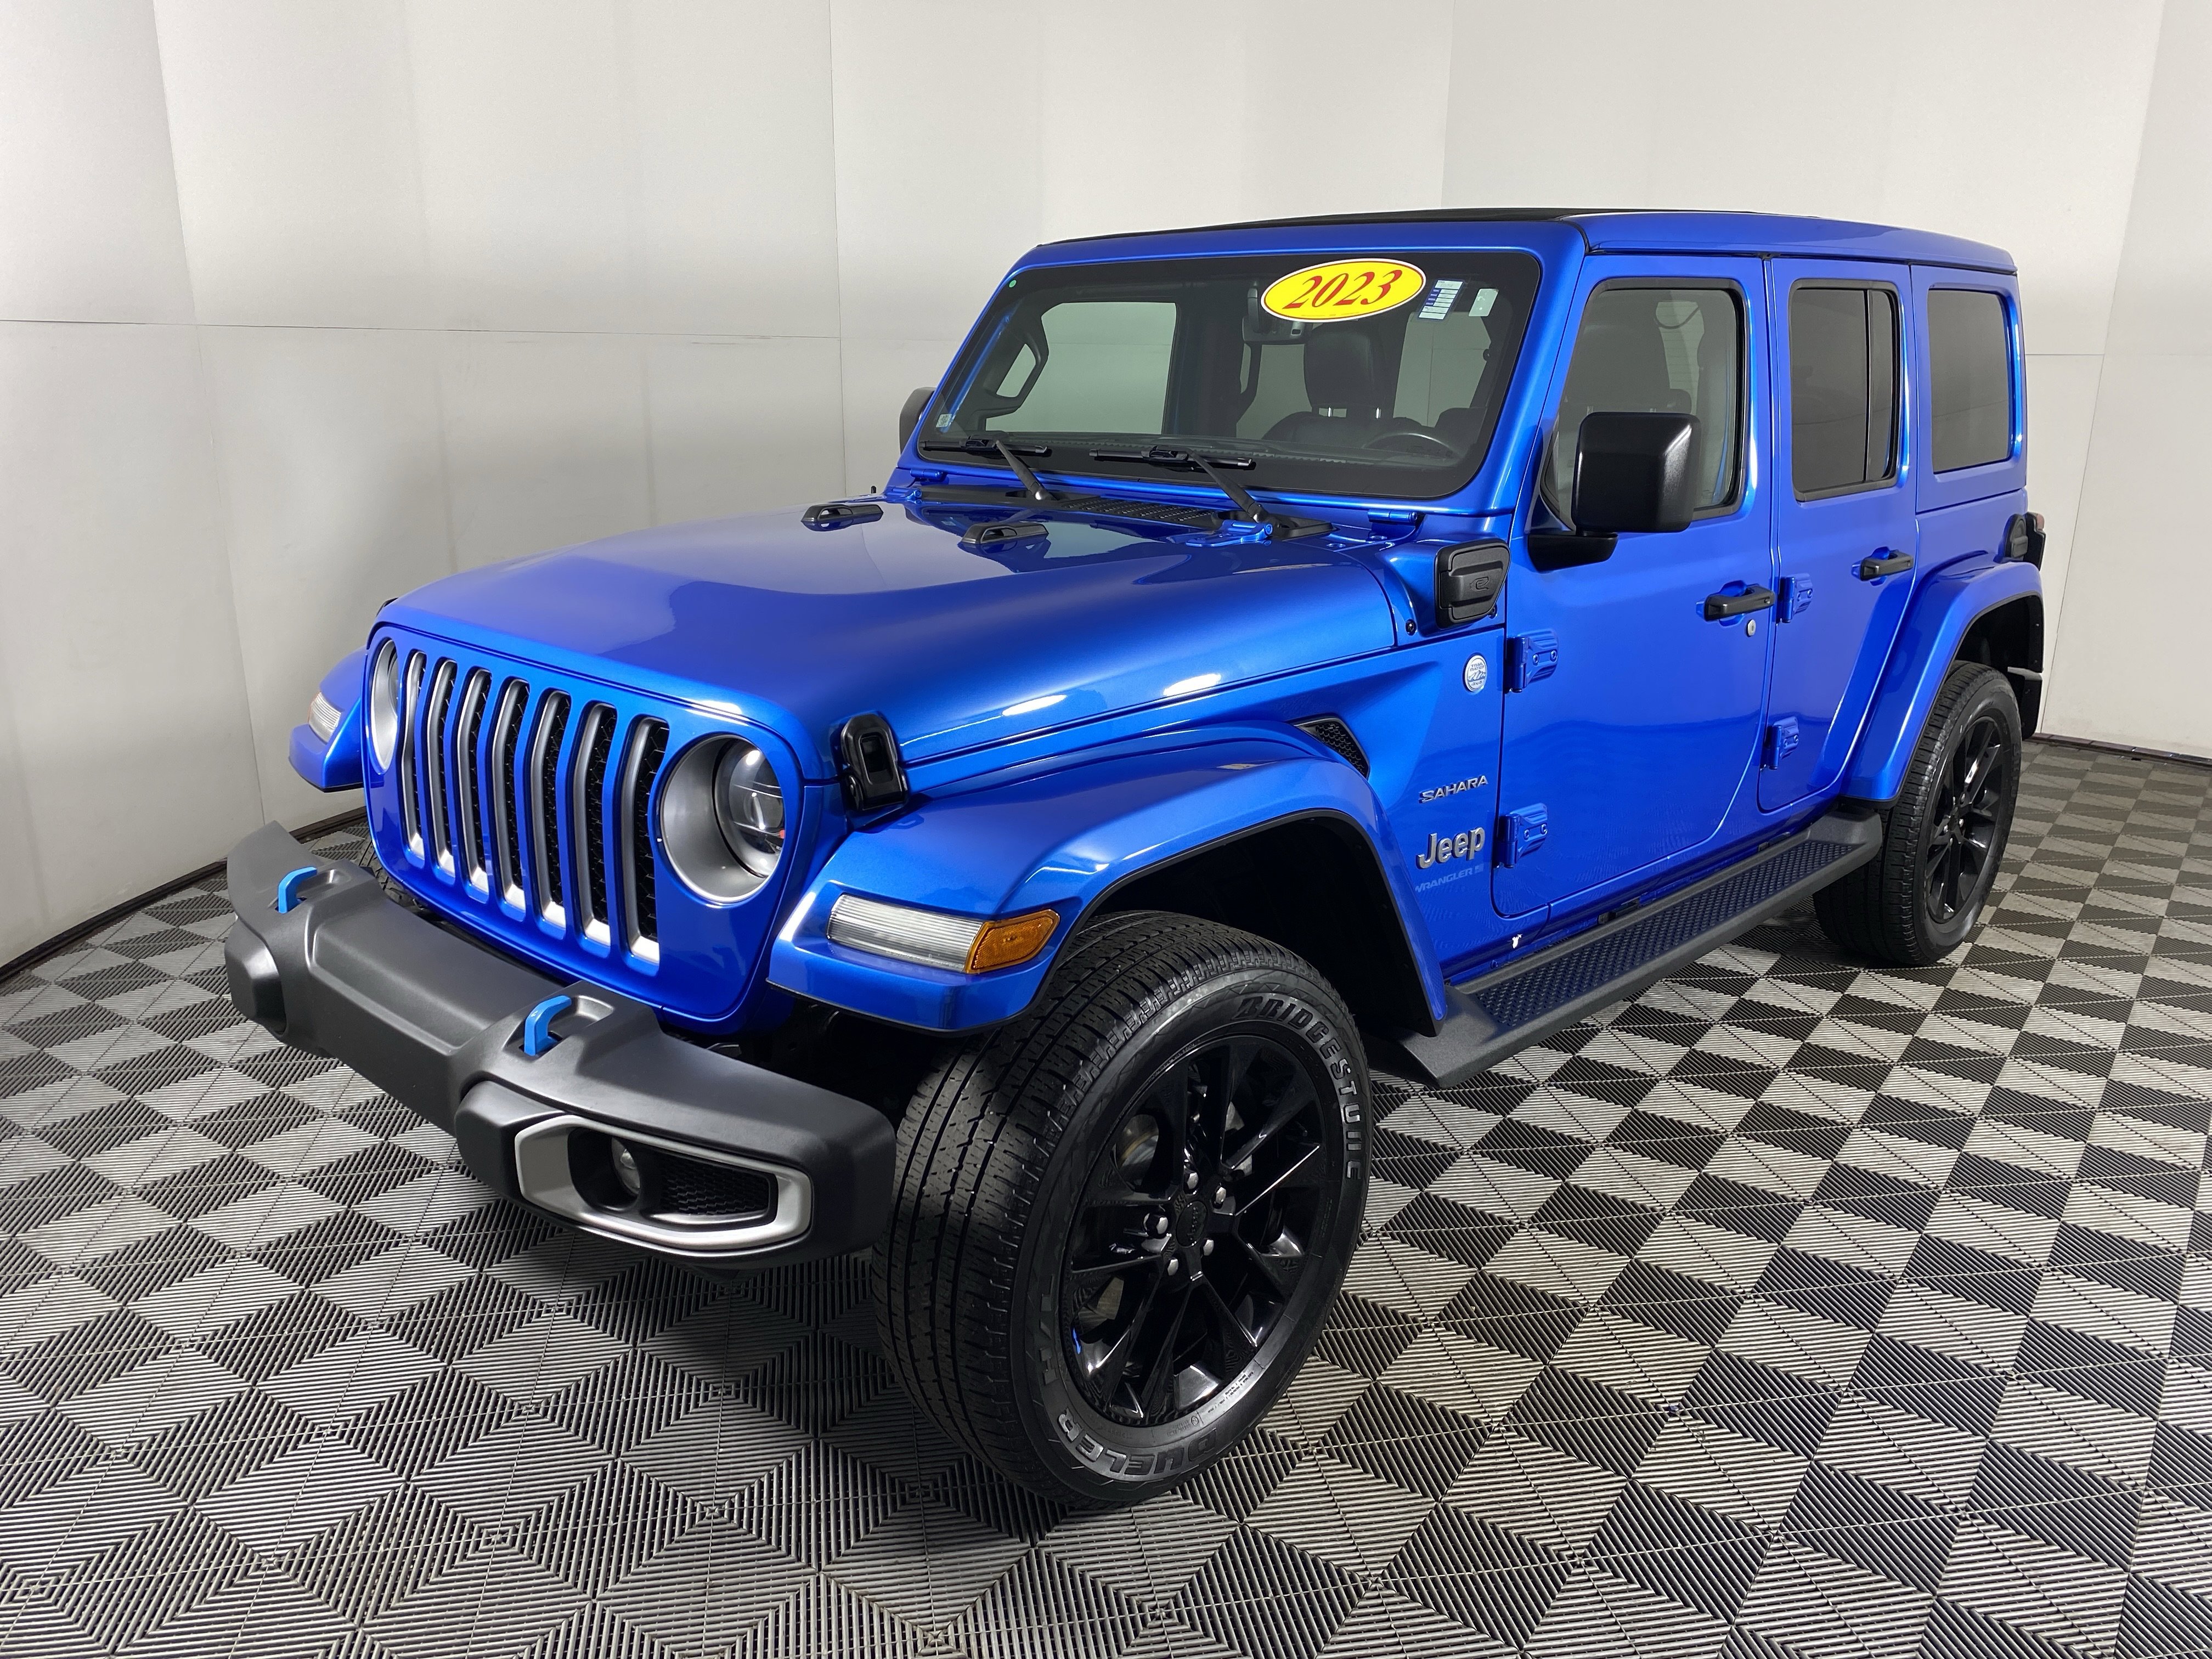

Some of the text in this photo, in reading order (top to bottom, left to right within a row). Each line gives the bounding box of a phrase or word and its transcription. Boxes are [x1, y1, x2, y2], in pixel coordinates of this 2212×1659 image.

[1282, 269, 1403, 309] 2023
[1419, 775, 1488, 803] SAHARA
[1416, 826, 1486, 870] Jeep
[1415, 867, 1474, 893] WRANGLER
[1057, 1407, 1217, 1477] DUELER
